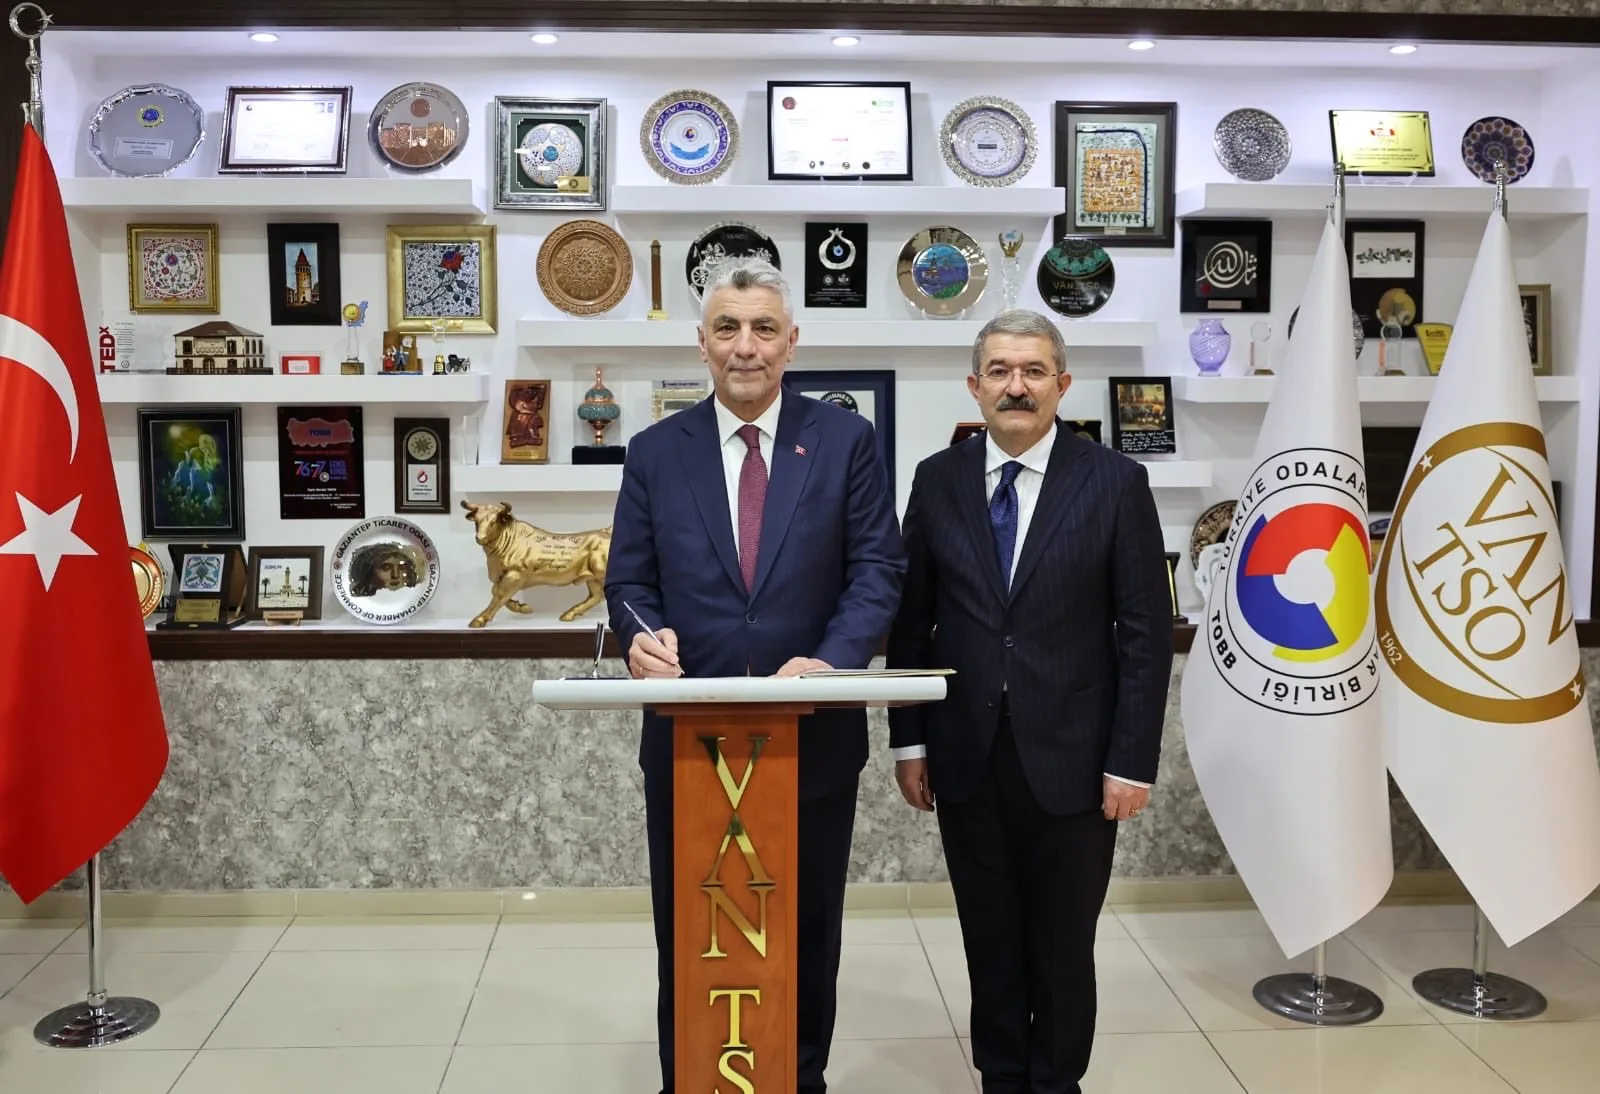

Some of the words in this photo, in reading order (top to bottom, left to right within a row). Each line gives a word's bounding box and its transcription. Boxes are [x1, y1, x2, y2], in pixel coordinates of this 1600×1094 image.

[1464, 462, 1574, 645] VAN
[334, 573, 362, 614] COMMERCE
[1412, 521, 1526, 661] TSO
[362, 610, 375, 620] OF
[375, 607, 416, 621] CHAMBER
[1211, 609, 1237, 669] TOBB
[1380, 630, 1403, 666] 1962
[1261, 676, 1361, 705] BİRLİĞİ
[696, 736, 776, 959] VAN
